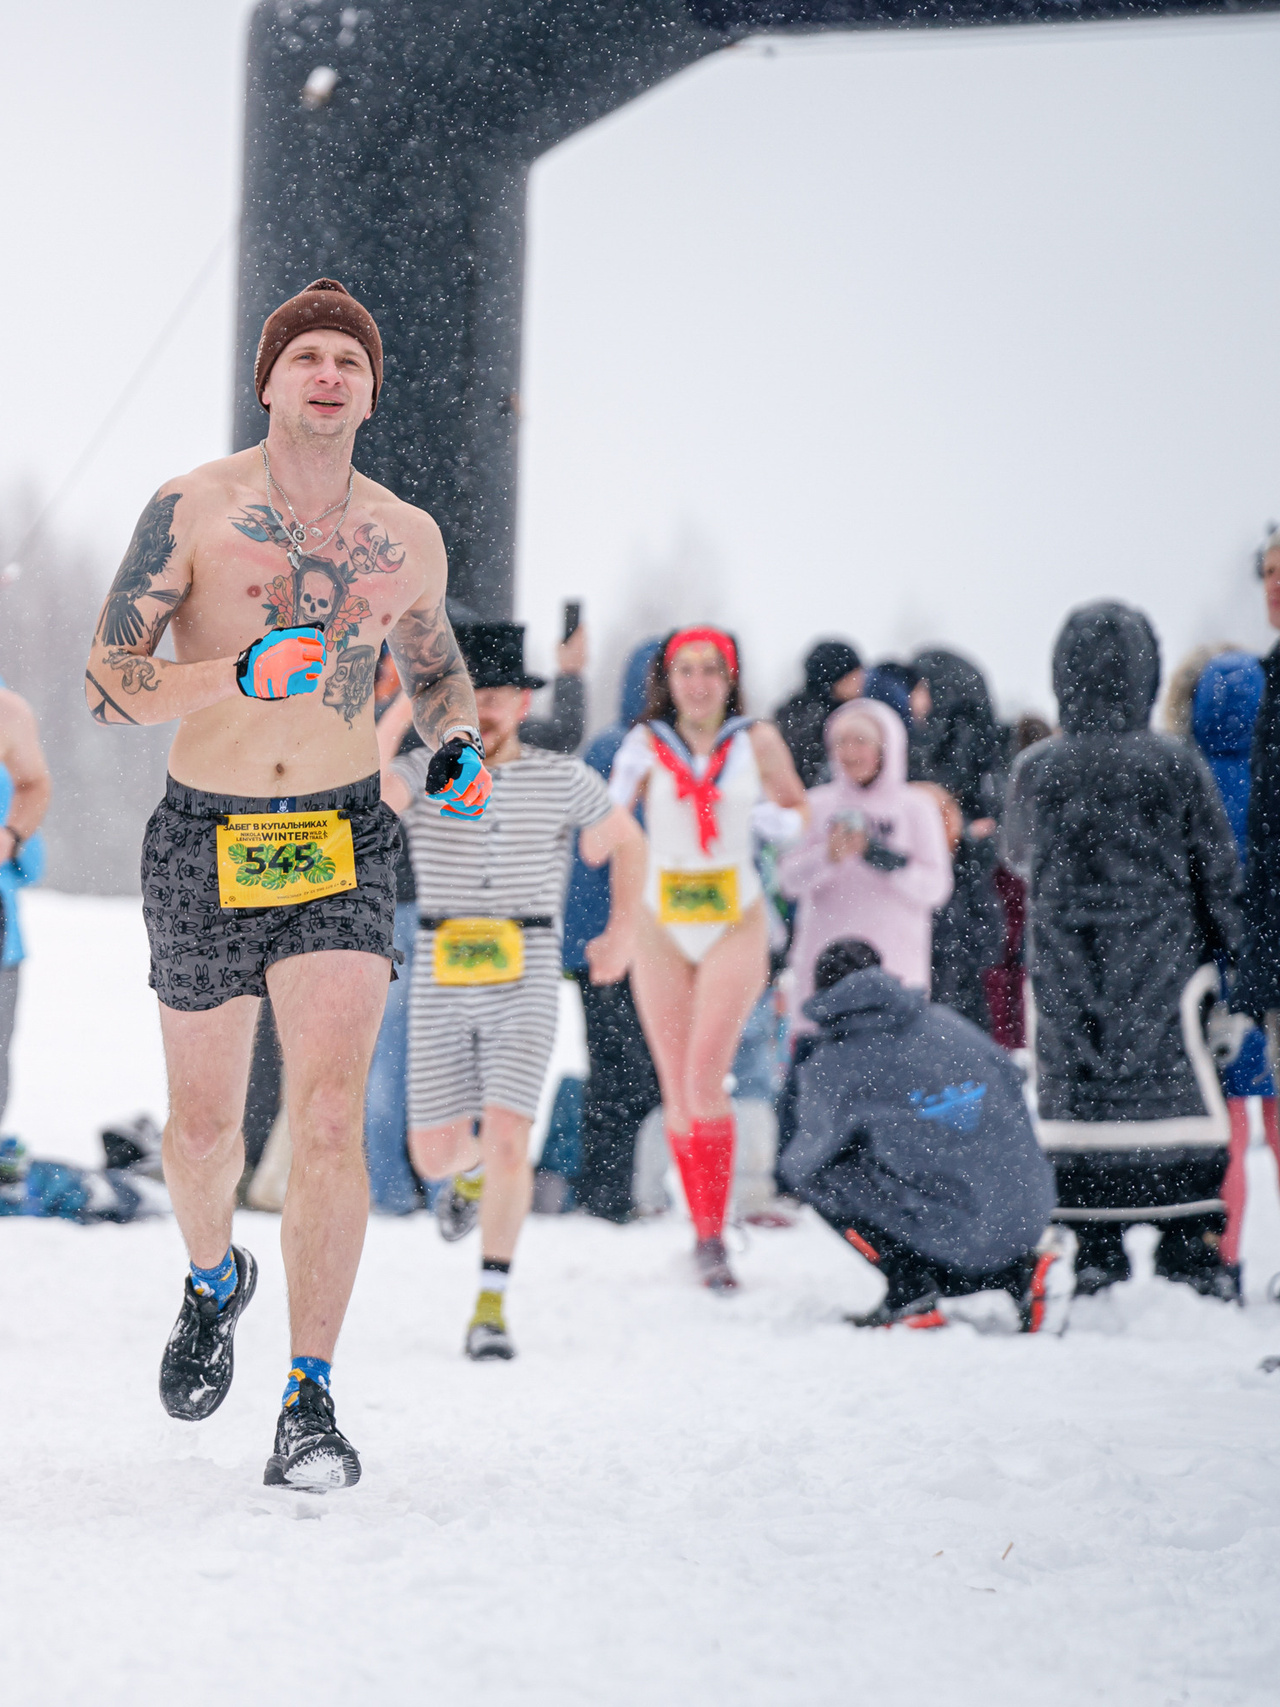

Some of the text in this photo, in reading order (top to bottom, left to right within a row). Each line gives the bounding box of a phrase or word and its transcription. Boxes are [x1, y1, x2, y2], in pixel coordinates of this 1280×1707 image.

[223, 823, 252, 831] ЗАБЕГ
[261, 820, 328, 830] КУПАЛЬНИКАХ
[262, 831, 309, 841] WINTER
[245, 844, 315, 875] 545
